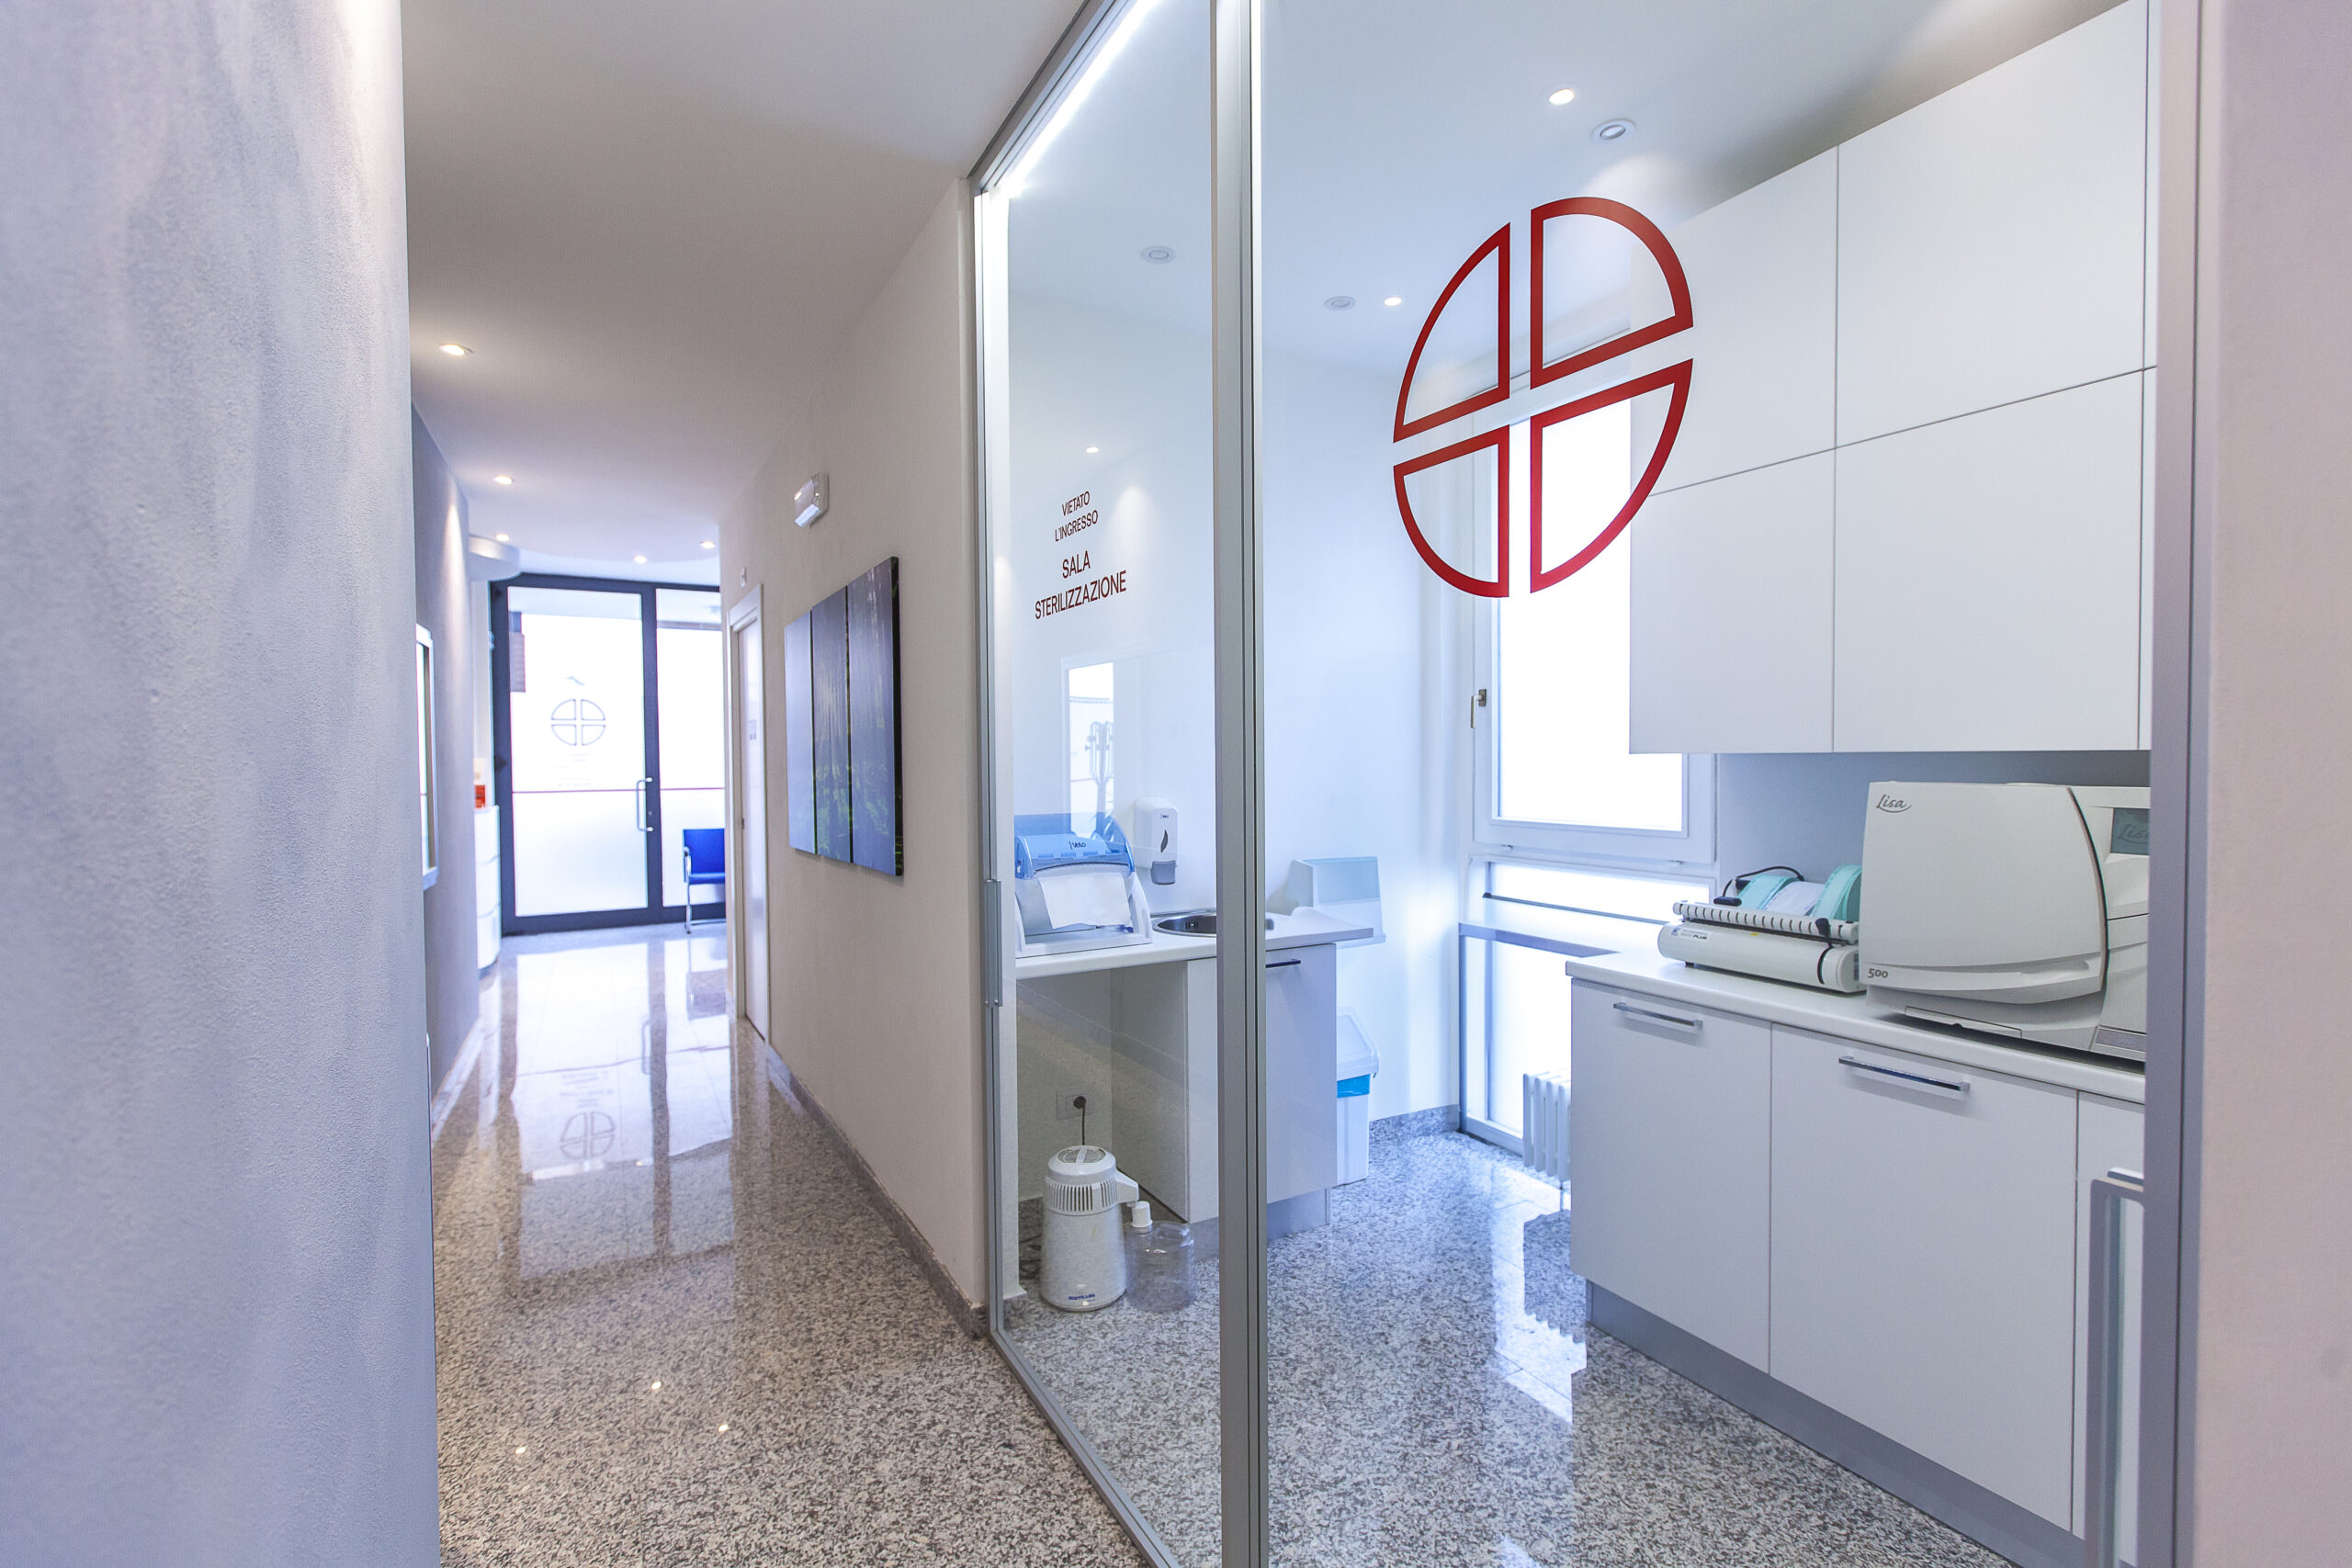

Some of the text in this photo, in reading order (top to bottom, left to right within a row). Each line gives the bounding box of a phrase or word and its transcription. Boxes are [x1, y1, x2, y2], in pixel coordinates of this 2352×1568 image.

[1062, 491, 1091, 516] VIETATO
[1055, 510, 1099, 542] L'INGRESSO
[1062, 550, 1091, 579] SALA
[1035, 570, 1126, 620] STERILIZZAZIONE
[1876, 794, 1908, 808] Lisa
[1867, 967, 1889, 979] 500
